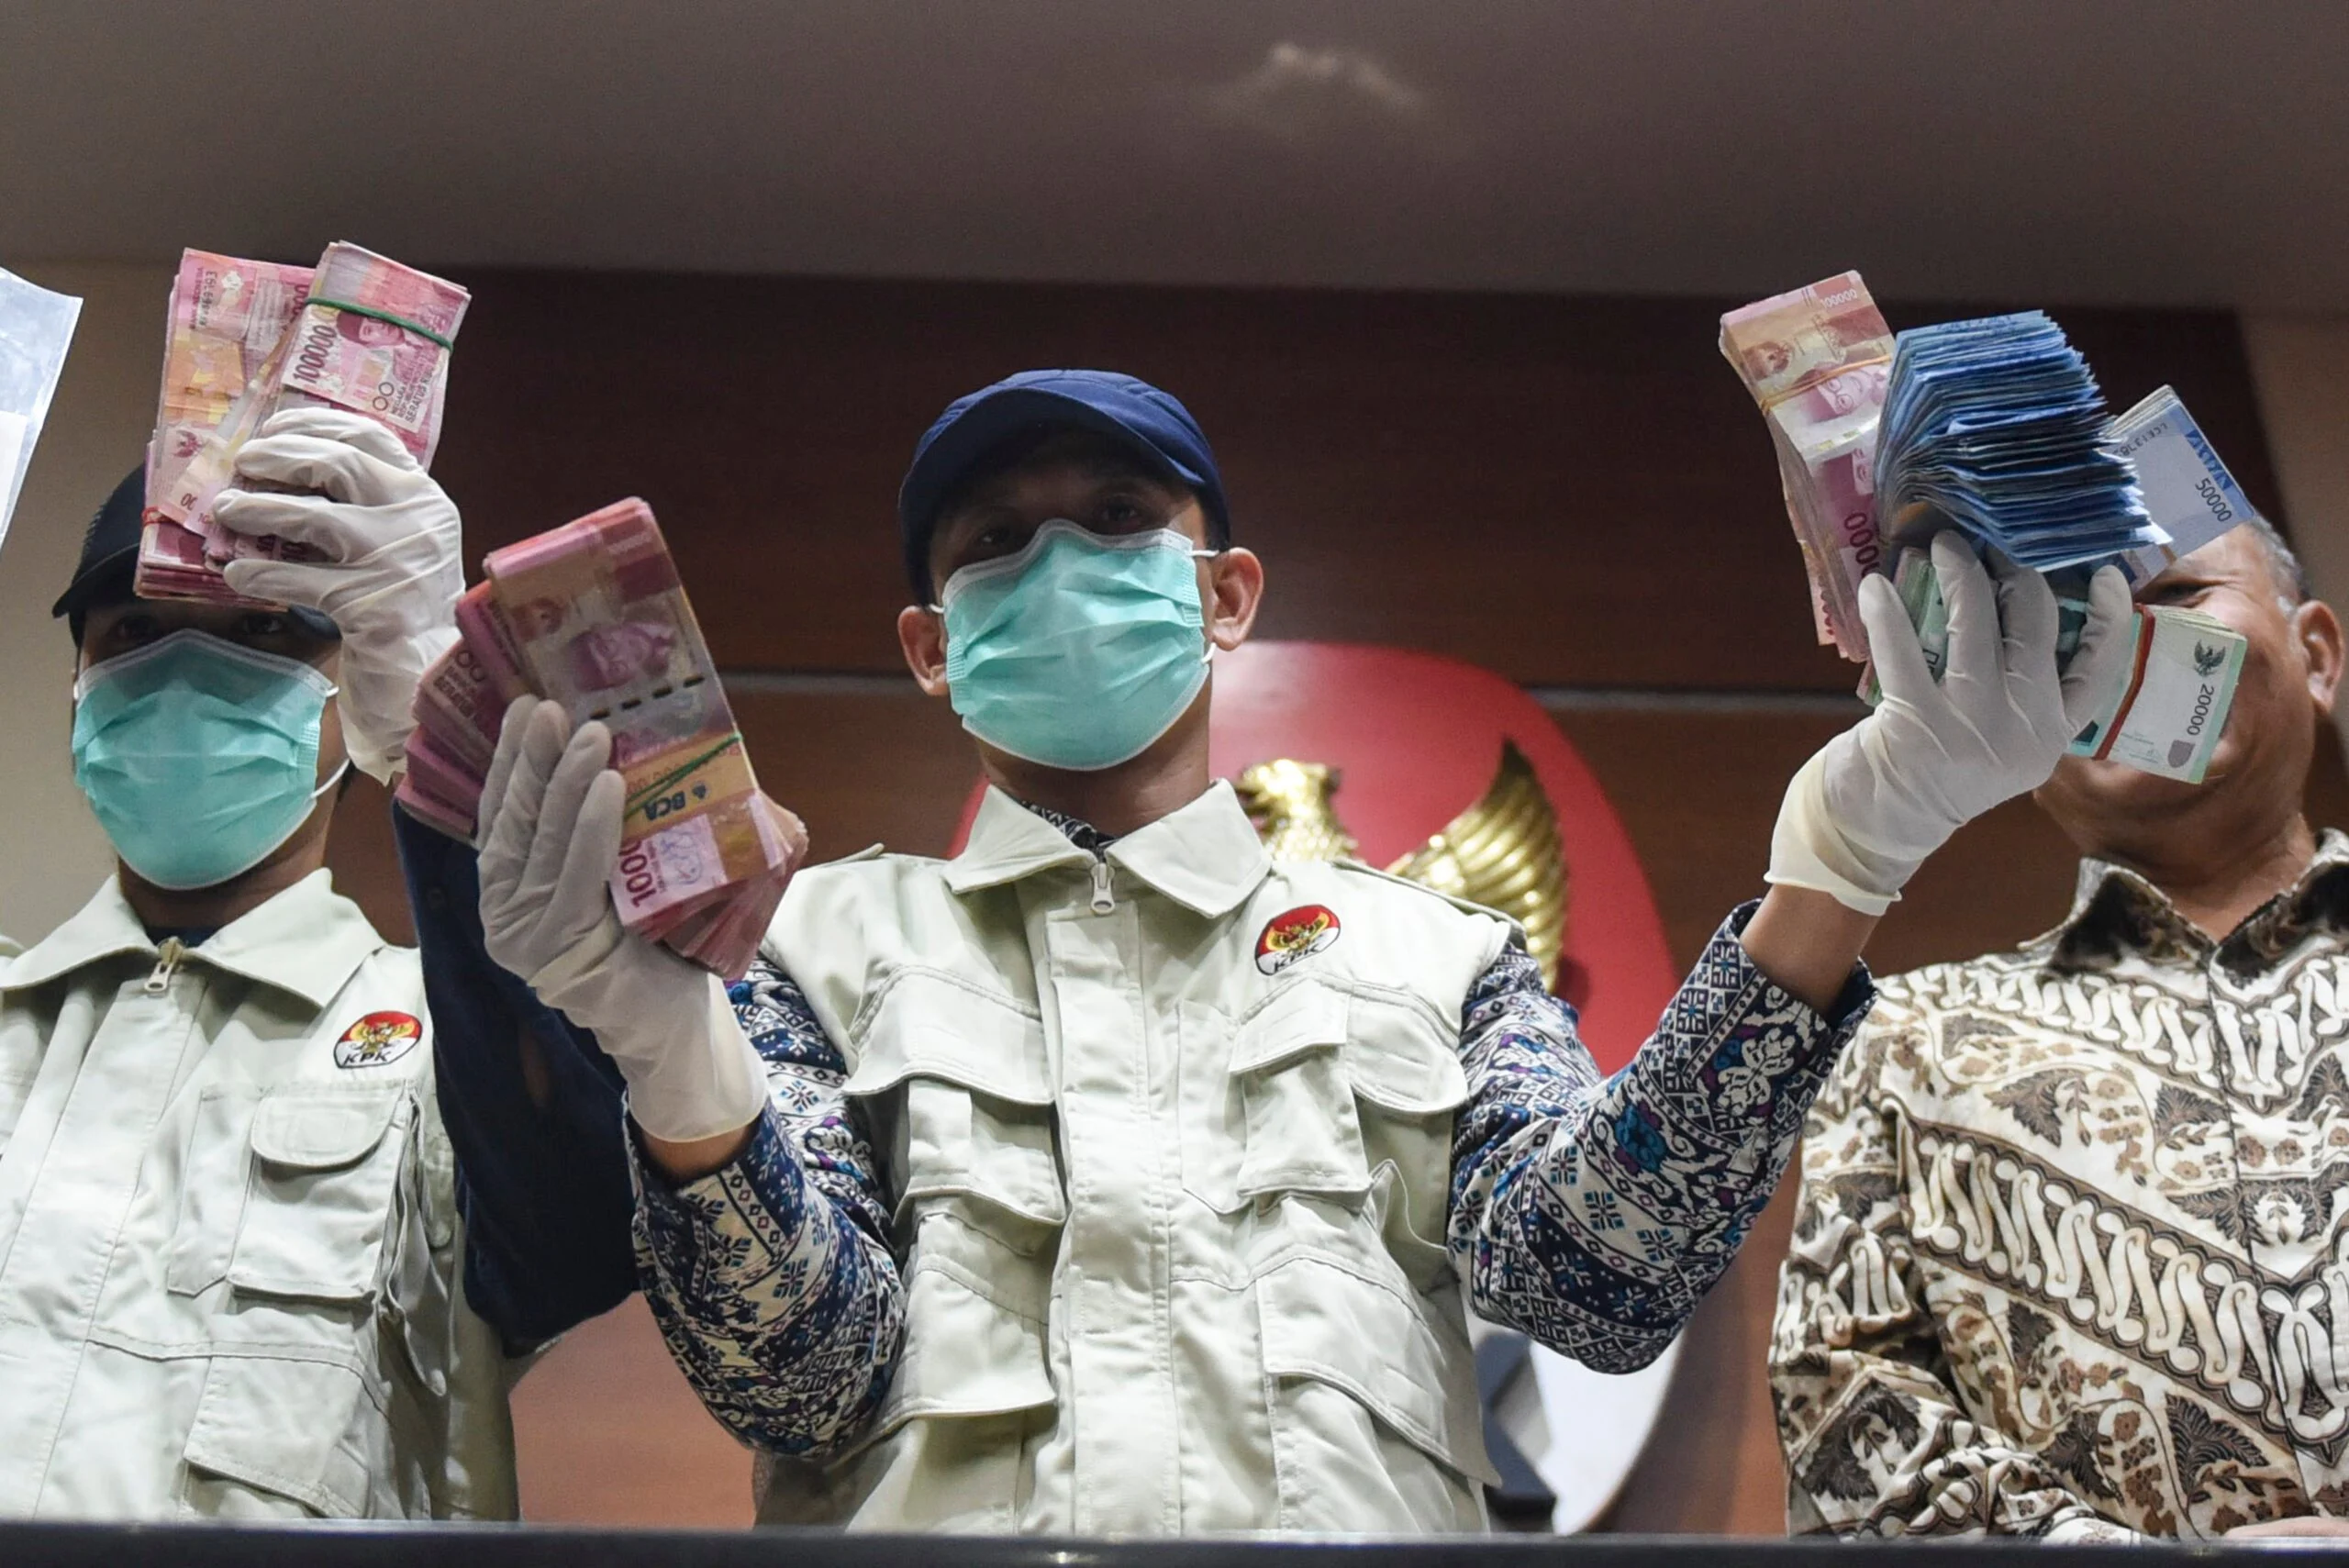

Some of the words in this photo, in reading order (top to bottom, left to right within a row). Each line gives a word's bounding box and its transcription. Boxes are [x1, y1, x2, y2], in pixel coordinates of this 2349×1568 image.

[1819, 288, 1858, 308] 100000
[293, 325, 337, 384] 100000
[405, 384, 428, 424] SERATUS
[2195, 477, 2232, 522] 50000
[2187, 683, 2215, 736] 20000
[644, 791, 685, 821] BCA
[343, 1051, 391, 1065] KPK
